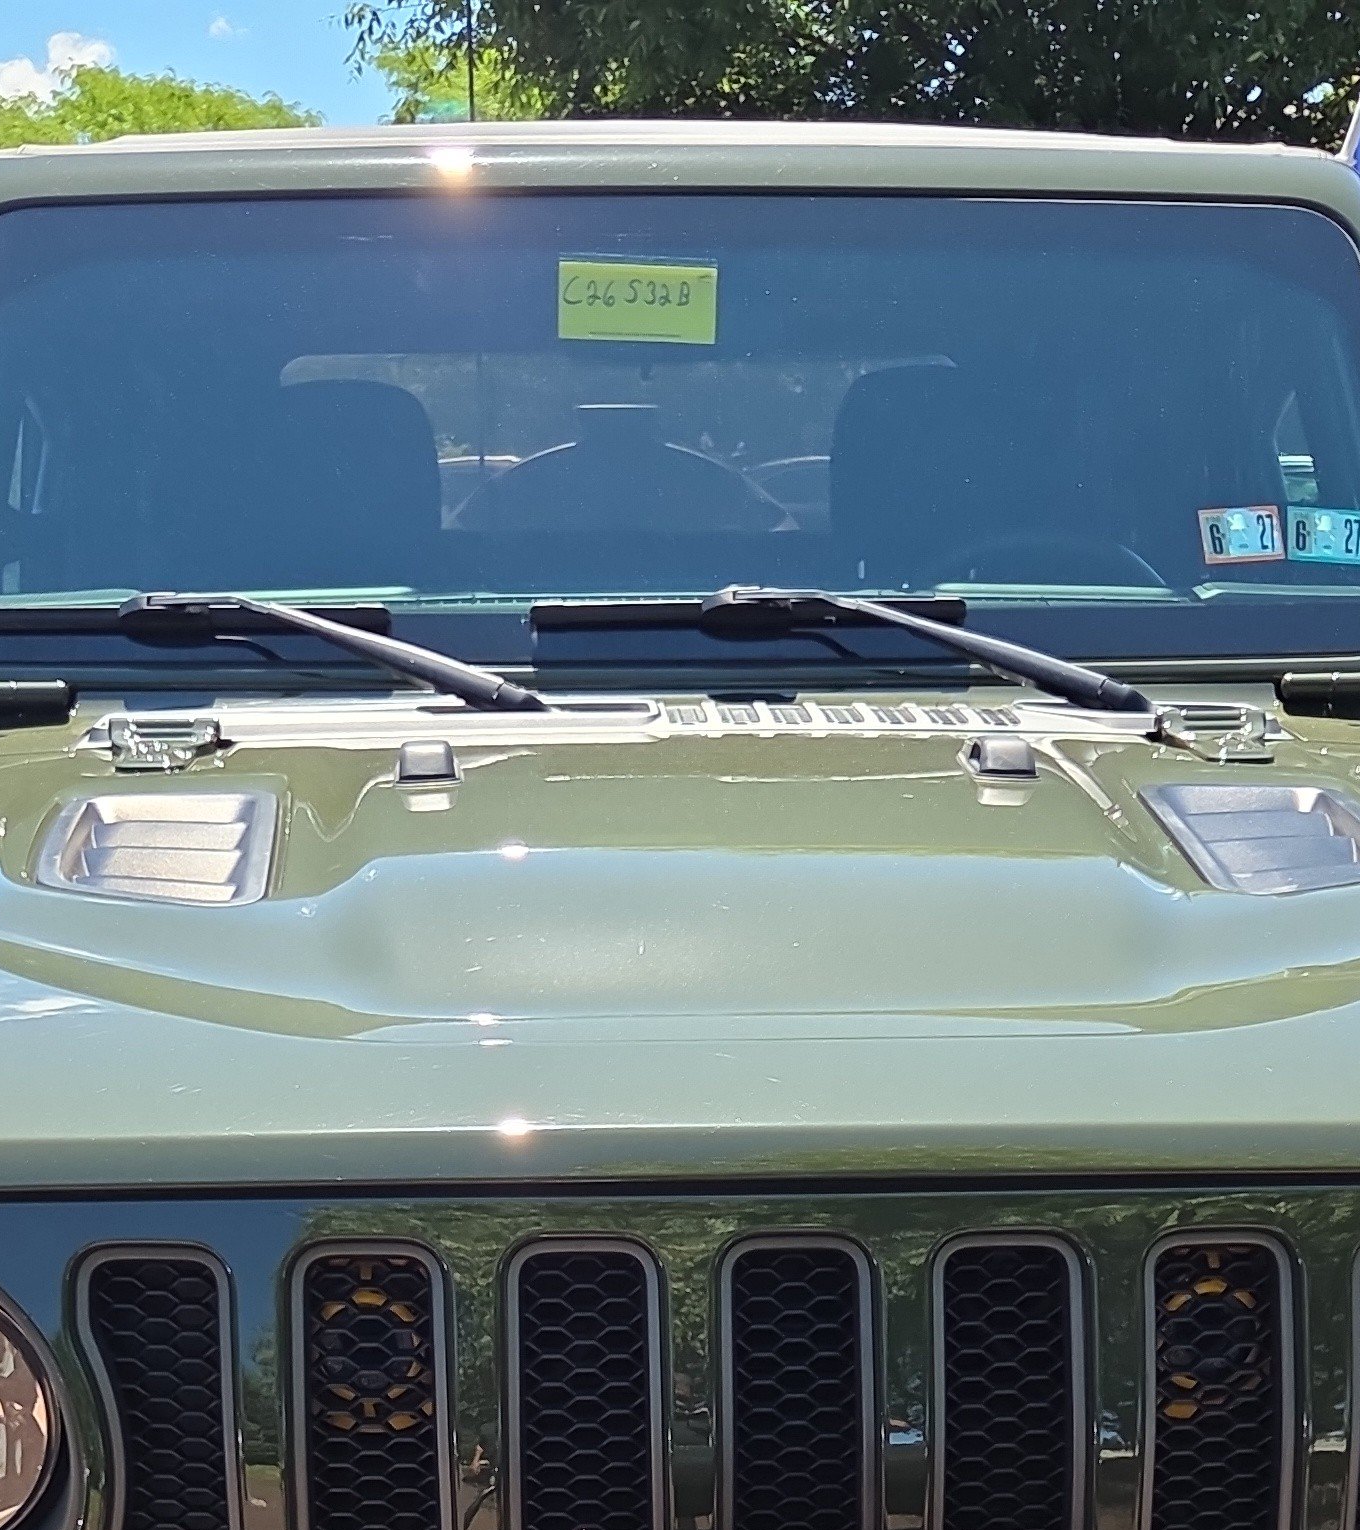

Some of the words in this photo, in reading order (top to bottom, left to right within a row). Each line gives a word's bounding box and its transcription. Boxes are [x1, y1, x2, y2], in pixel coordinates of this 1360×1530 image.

[1209, 523, 1224, 555] 6
[1256, 513, 1276, 553] 27
[1295, 519, 1307, 551] 6
